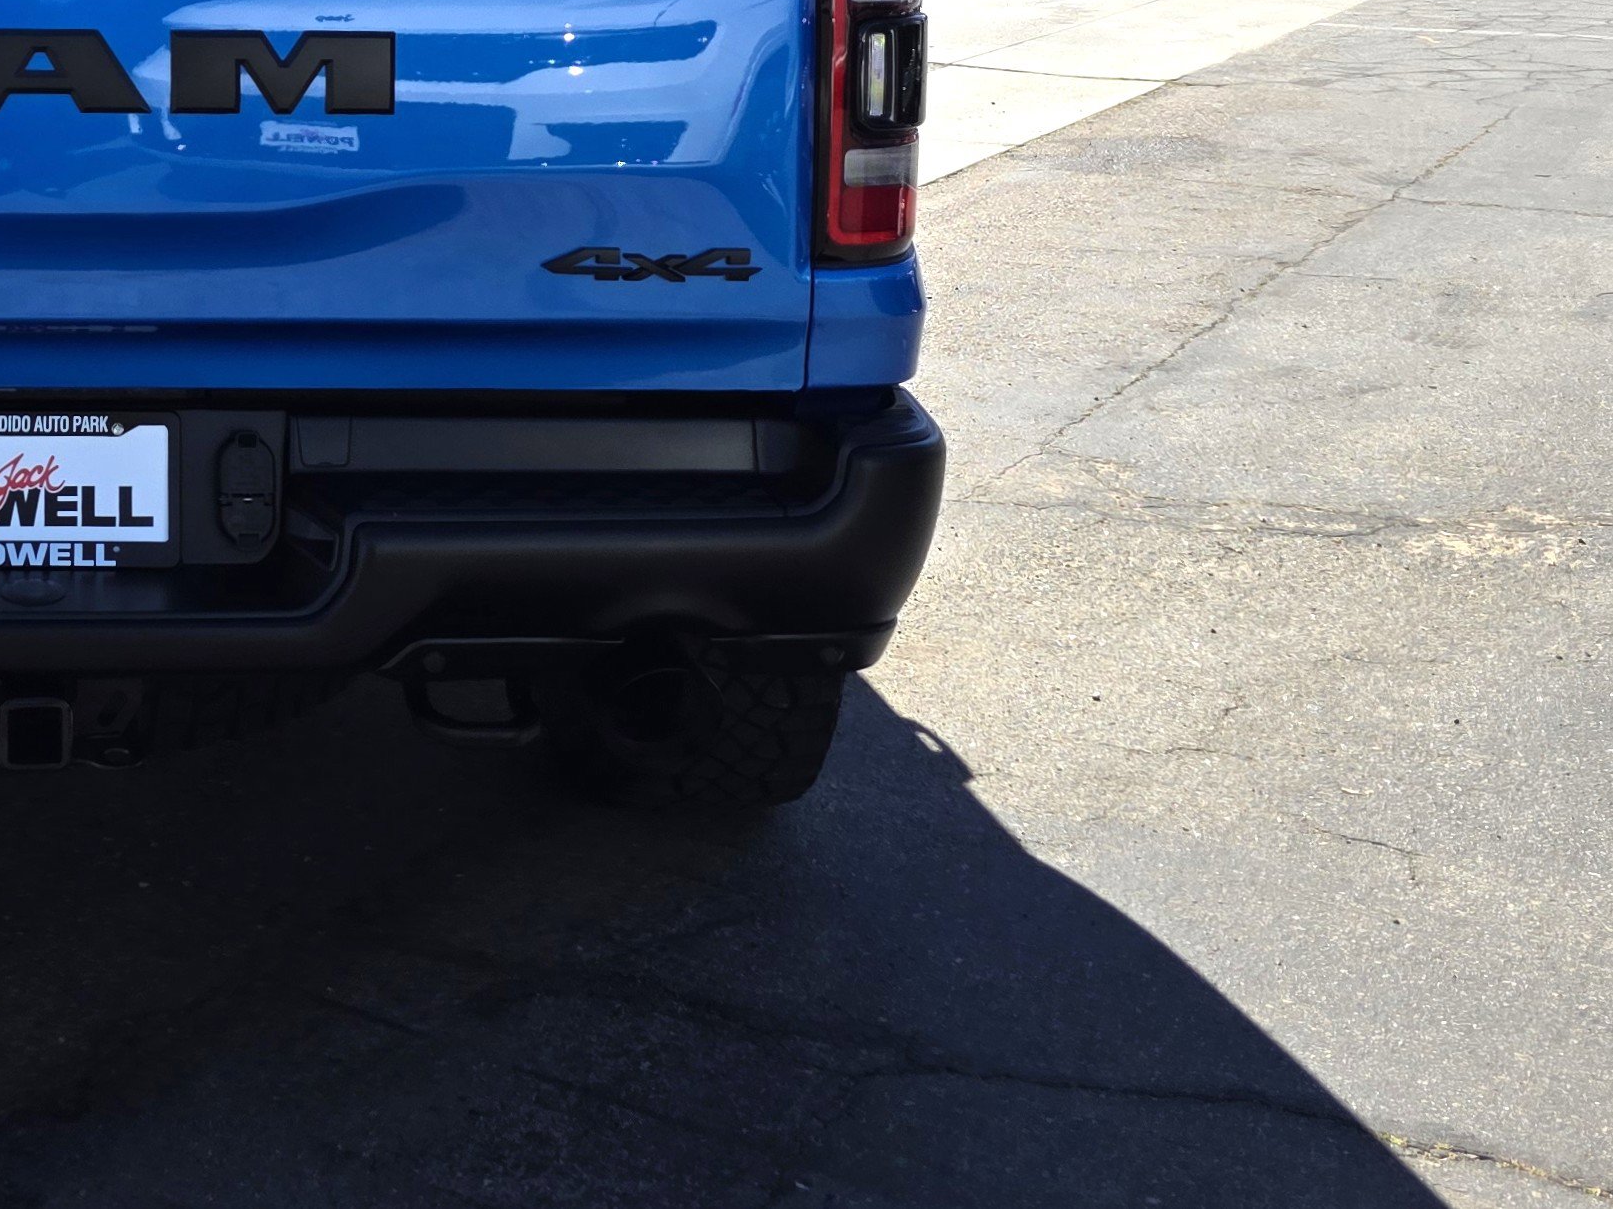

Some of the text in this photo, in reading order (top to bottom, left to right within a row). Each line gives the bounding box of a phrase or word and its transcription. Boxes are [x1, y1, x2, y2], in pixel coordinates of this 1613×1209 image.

[540, 247, 763, 282] 4x4
[33, 416, 70, 433] AUTO
[73, 416, 109, 433] PARK
